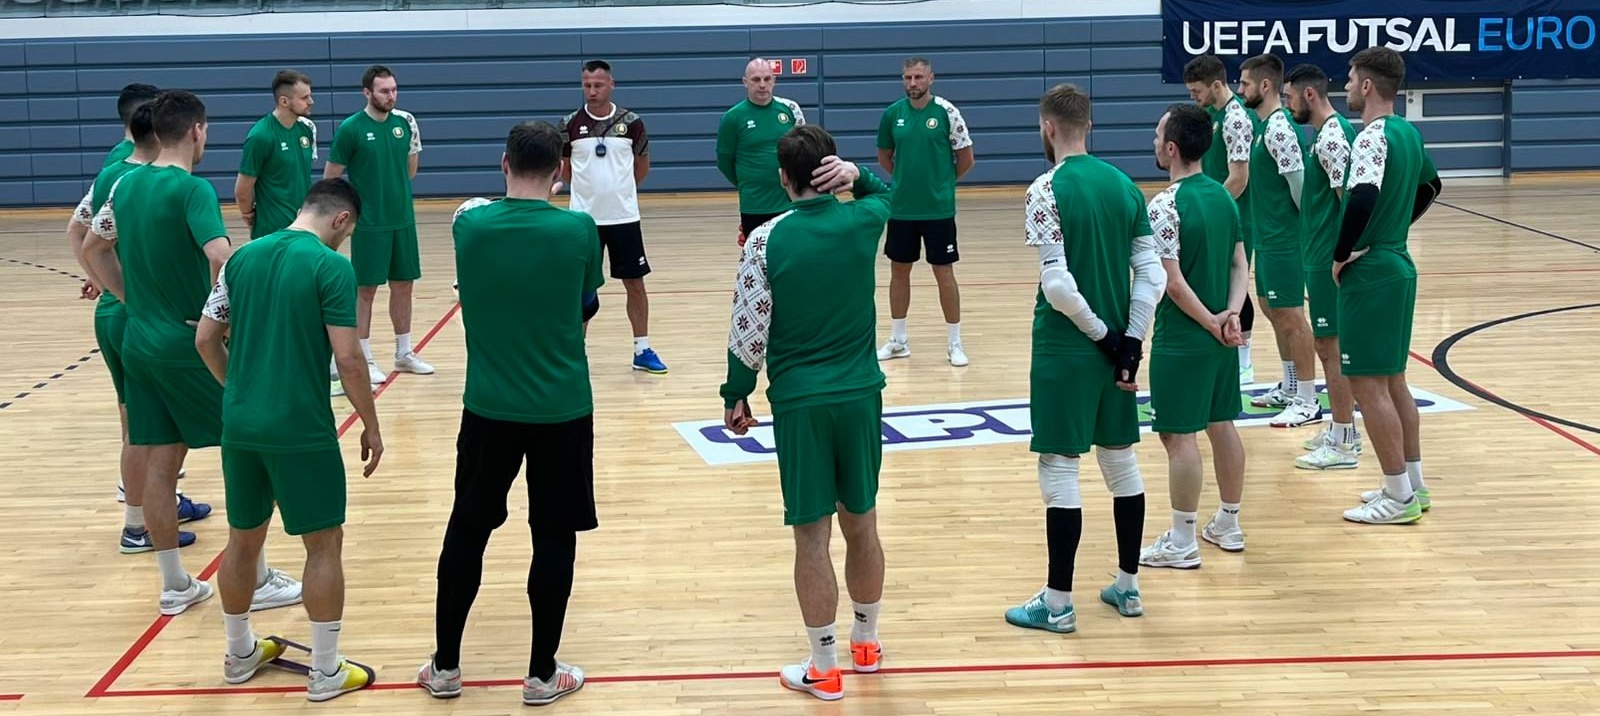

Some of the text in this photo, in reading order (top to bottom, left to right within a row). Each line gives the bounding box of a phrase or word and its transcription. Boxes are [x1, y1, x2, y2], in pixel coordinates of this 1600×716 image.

[1183, 15, 1596, 55] UEFA FUTSAL EURO
